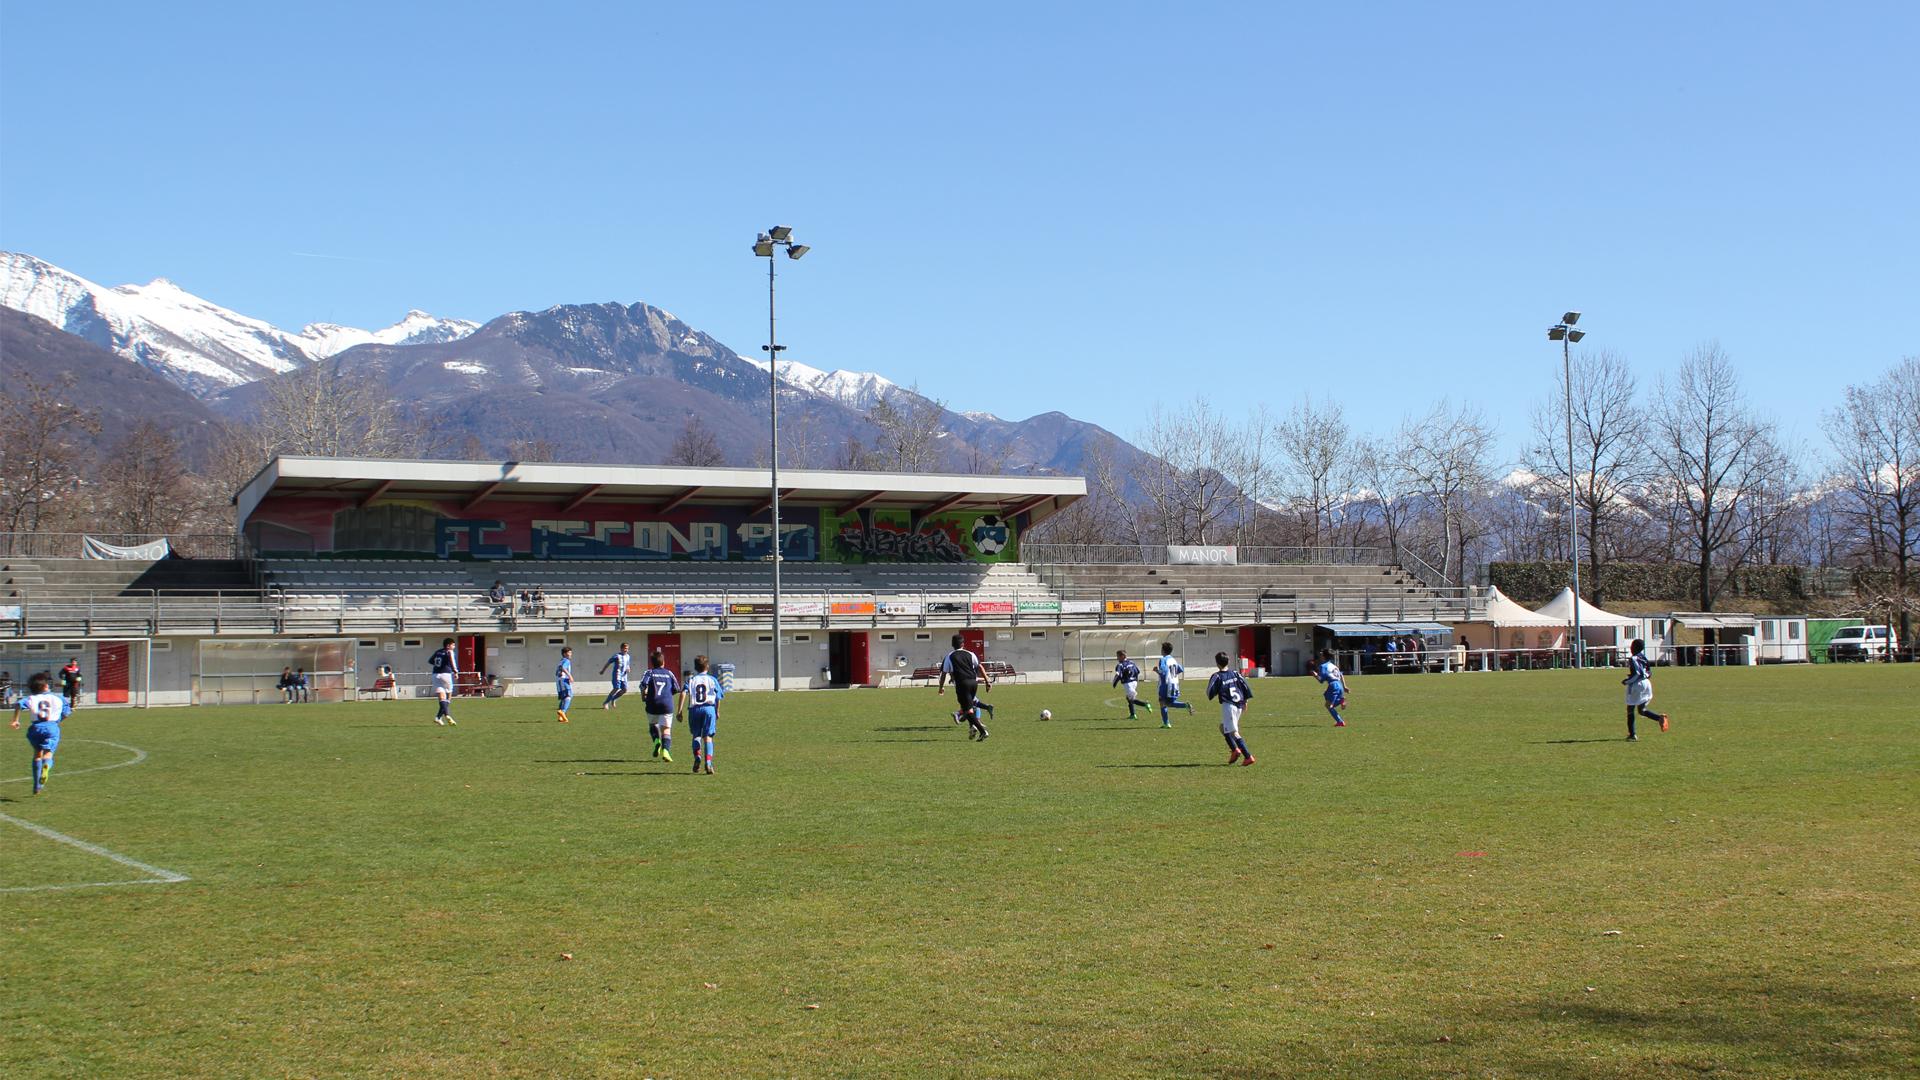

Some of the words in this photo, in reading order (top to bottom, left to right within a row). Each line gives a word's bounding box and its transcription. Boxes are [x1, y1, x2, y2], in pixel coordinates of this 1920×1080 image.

[436, 519, 513, 559] FC
[531, 519, 728, 560] ASCONA
[1178, 548, 1229, 562] MANOR
[656, 681, 666, 696] 7
[695, 683, 707, 703] 8
[1229, 686, 1241, 703] 5
